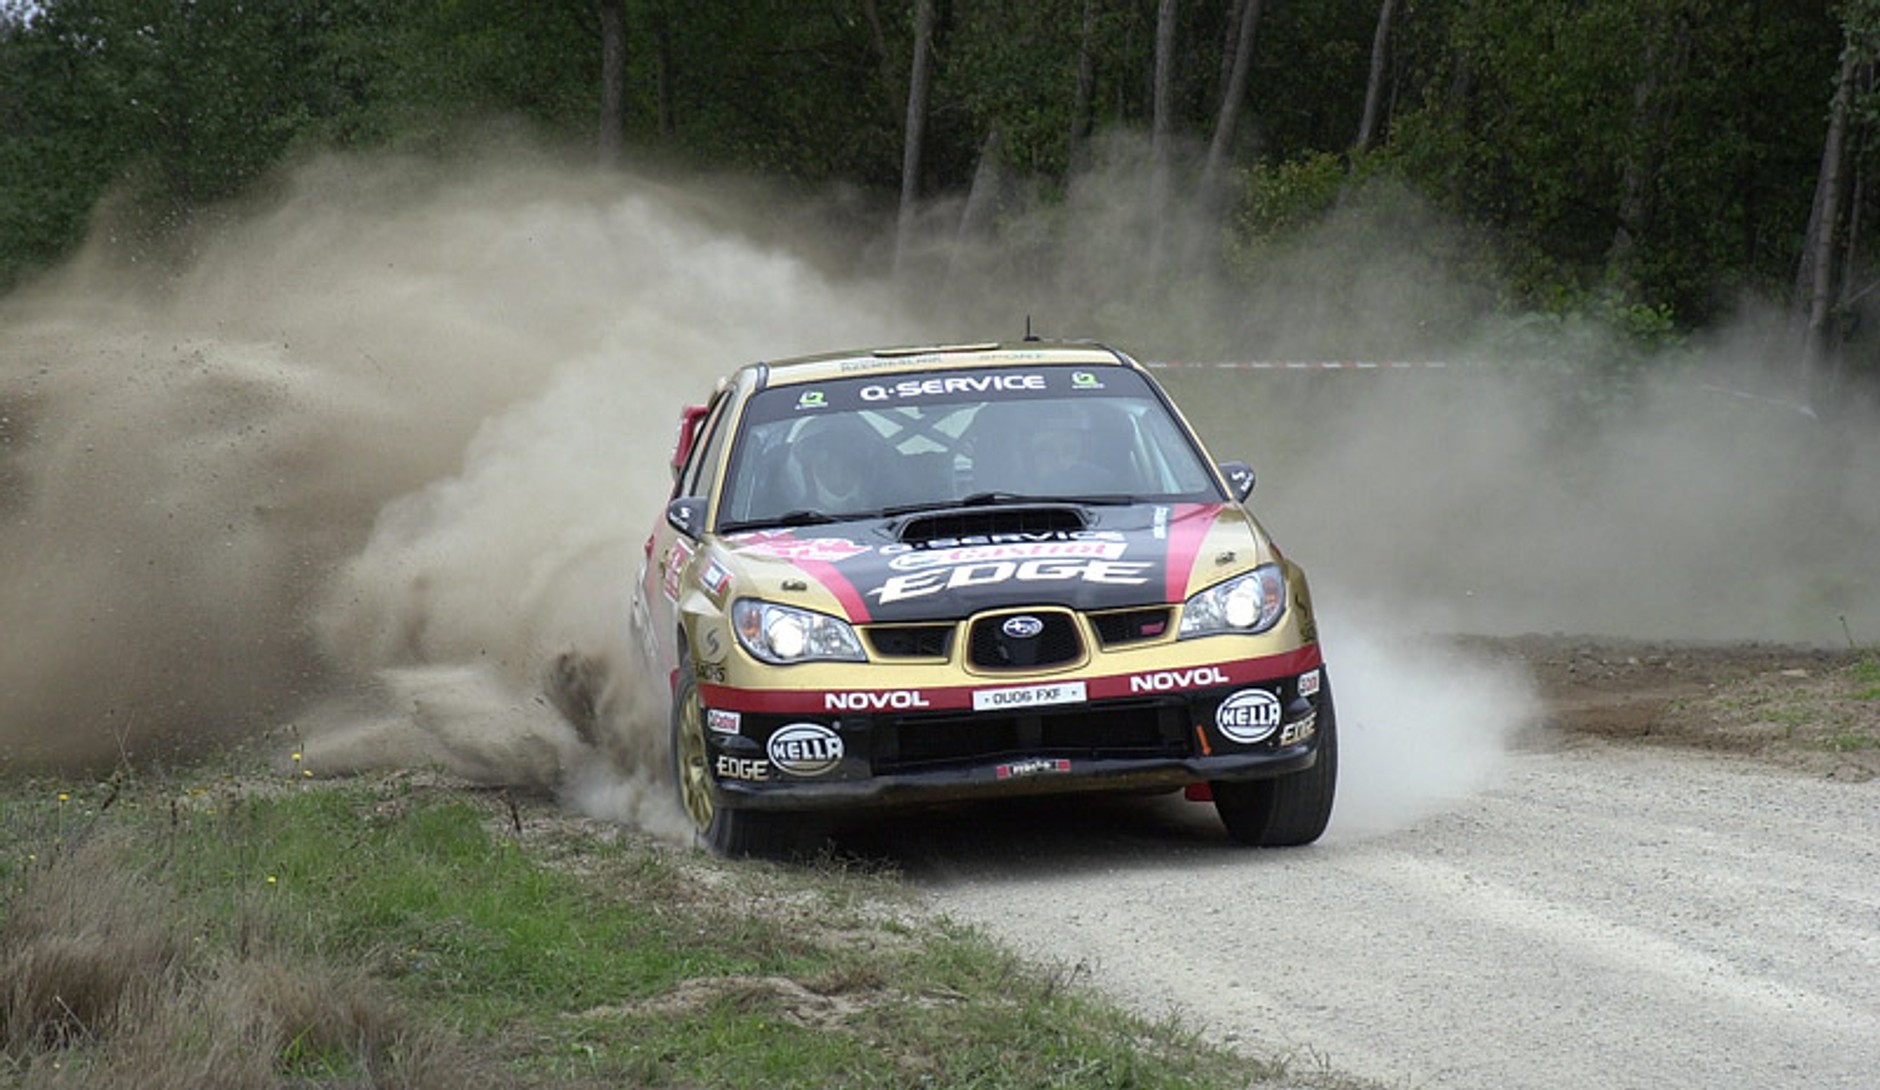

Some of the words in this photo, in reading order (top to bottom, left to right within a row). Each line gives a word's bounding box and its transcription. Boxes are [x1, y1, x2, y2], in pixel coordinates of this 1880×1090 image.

[867, 559, 1155, 605] EDGE
[1130, 667, 1230, 693] NOVOL
[824, 690, 930, 710] NOVOL
[1221, 702, 1282, 726] HELLA
[771, 737, 844, 760] HELLA
[716, 754, 770, 781] EDGE
